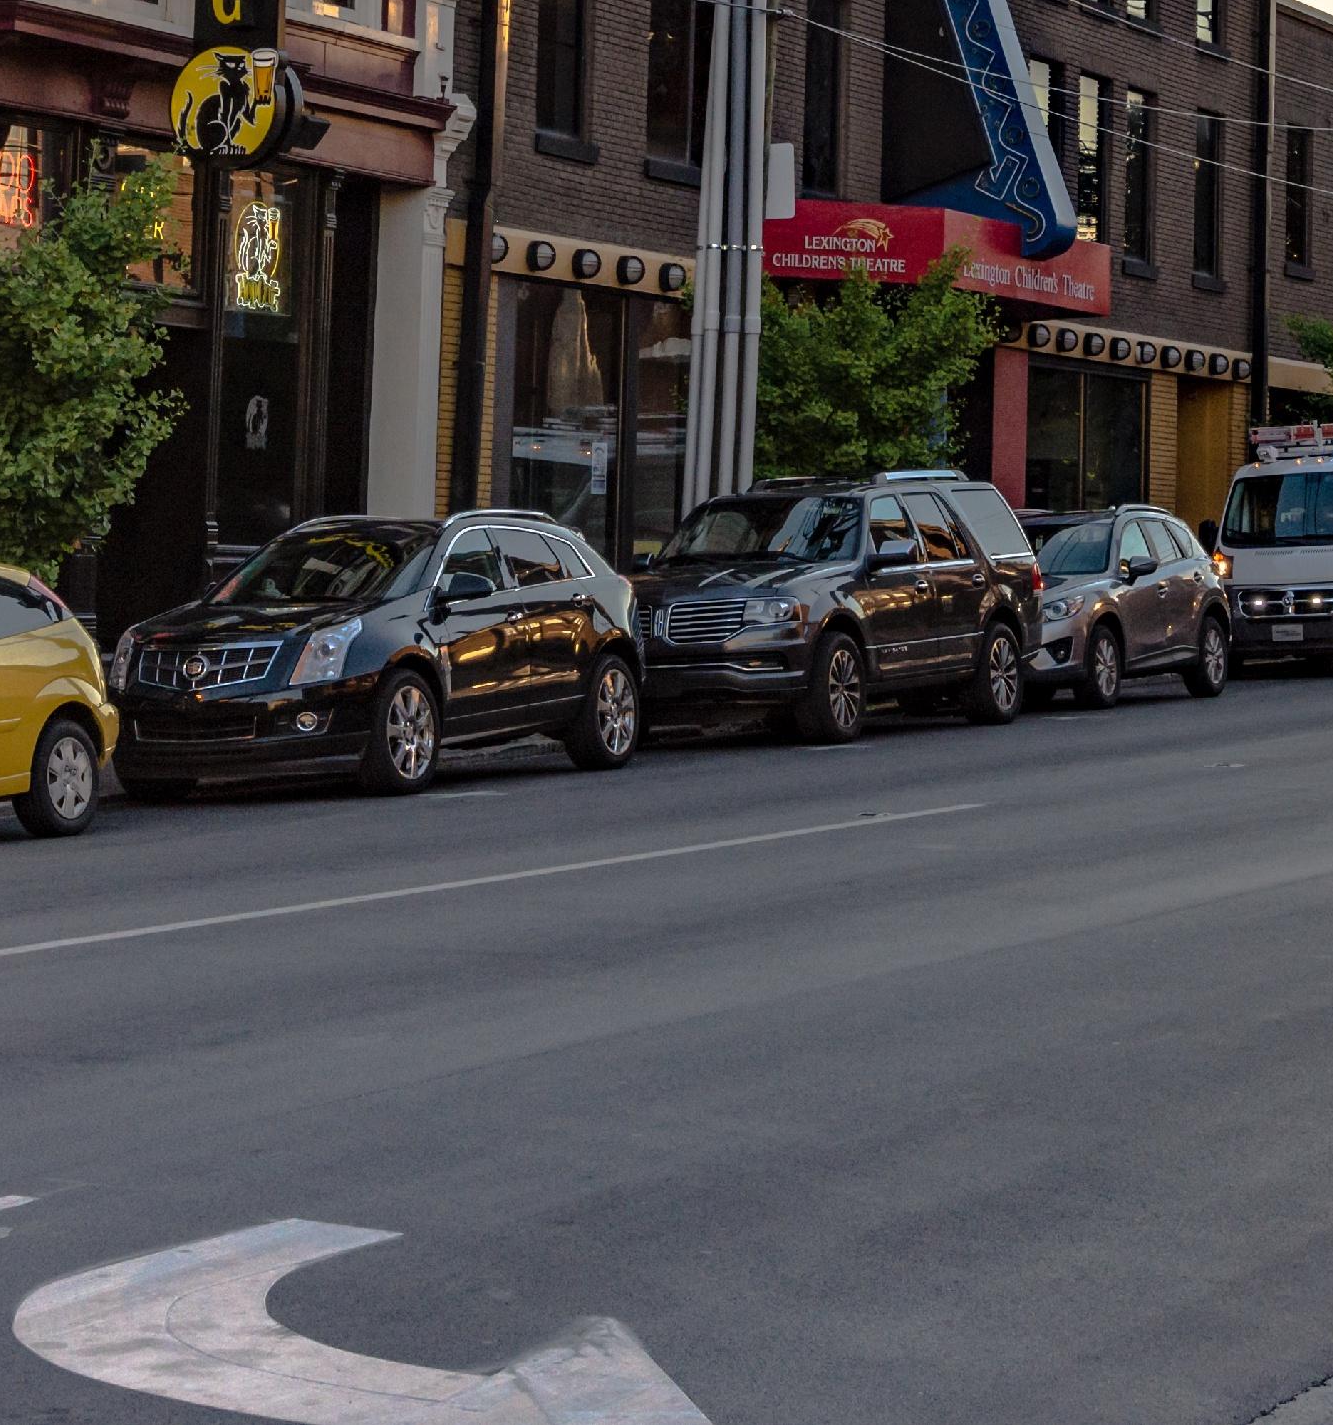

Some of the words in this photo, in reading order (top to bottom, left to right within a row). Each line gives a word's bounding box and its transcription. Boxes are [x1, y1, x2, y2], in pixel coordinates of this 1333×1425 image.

[804, 235, 876, 253] LEXINGTON
[772, 253, 846, 270] CHILDREN'S
[850, 256, 906, 273] THEATRE
[963, 261, 1010, 287] Lexington
[1015, 265, 1059, 294] Children's
[1062, 273, 1095, 301] Theatre
